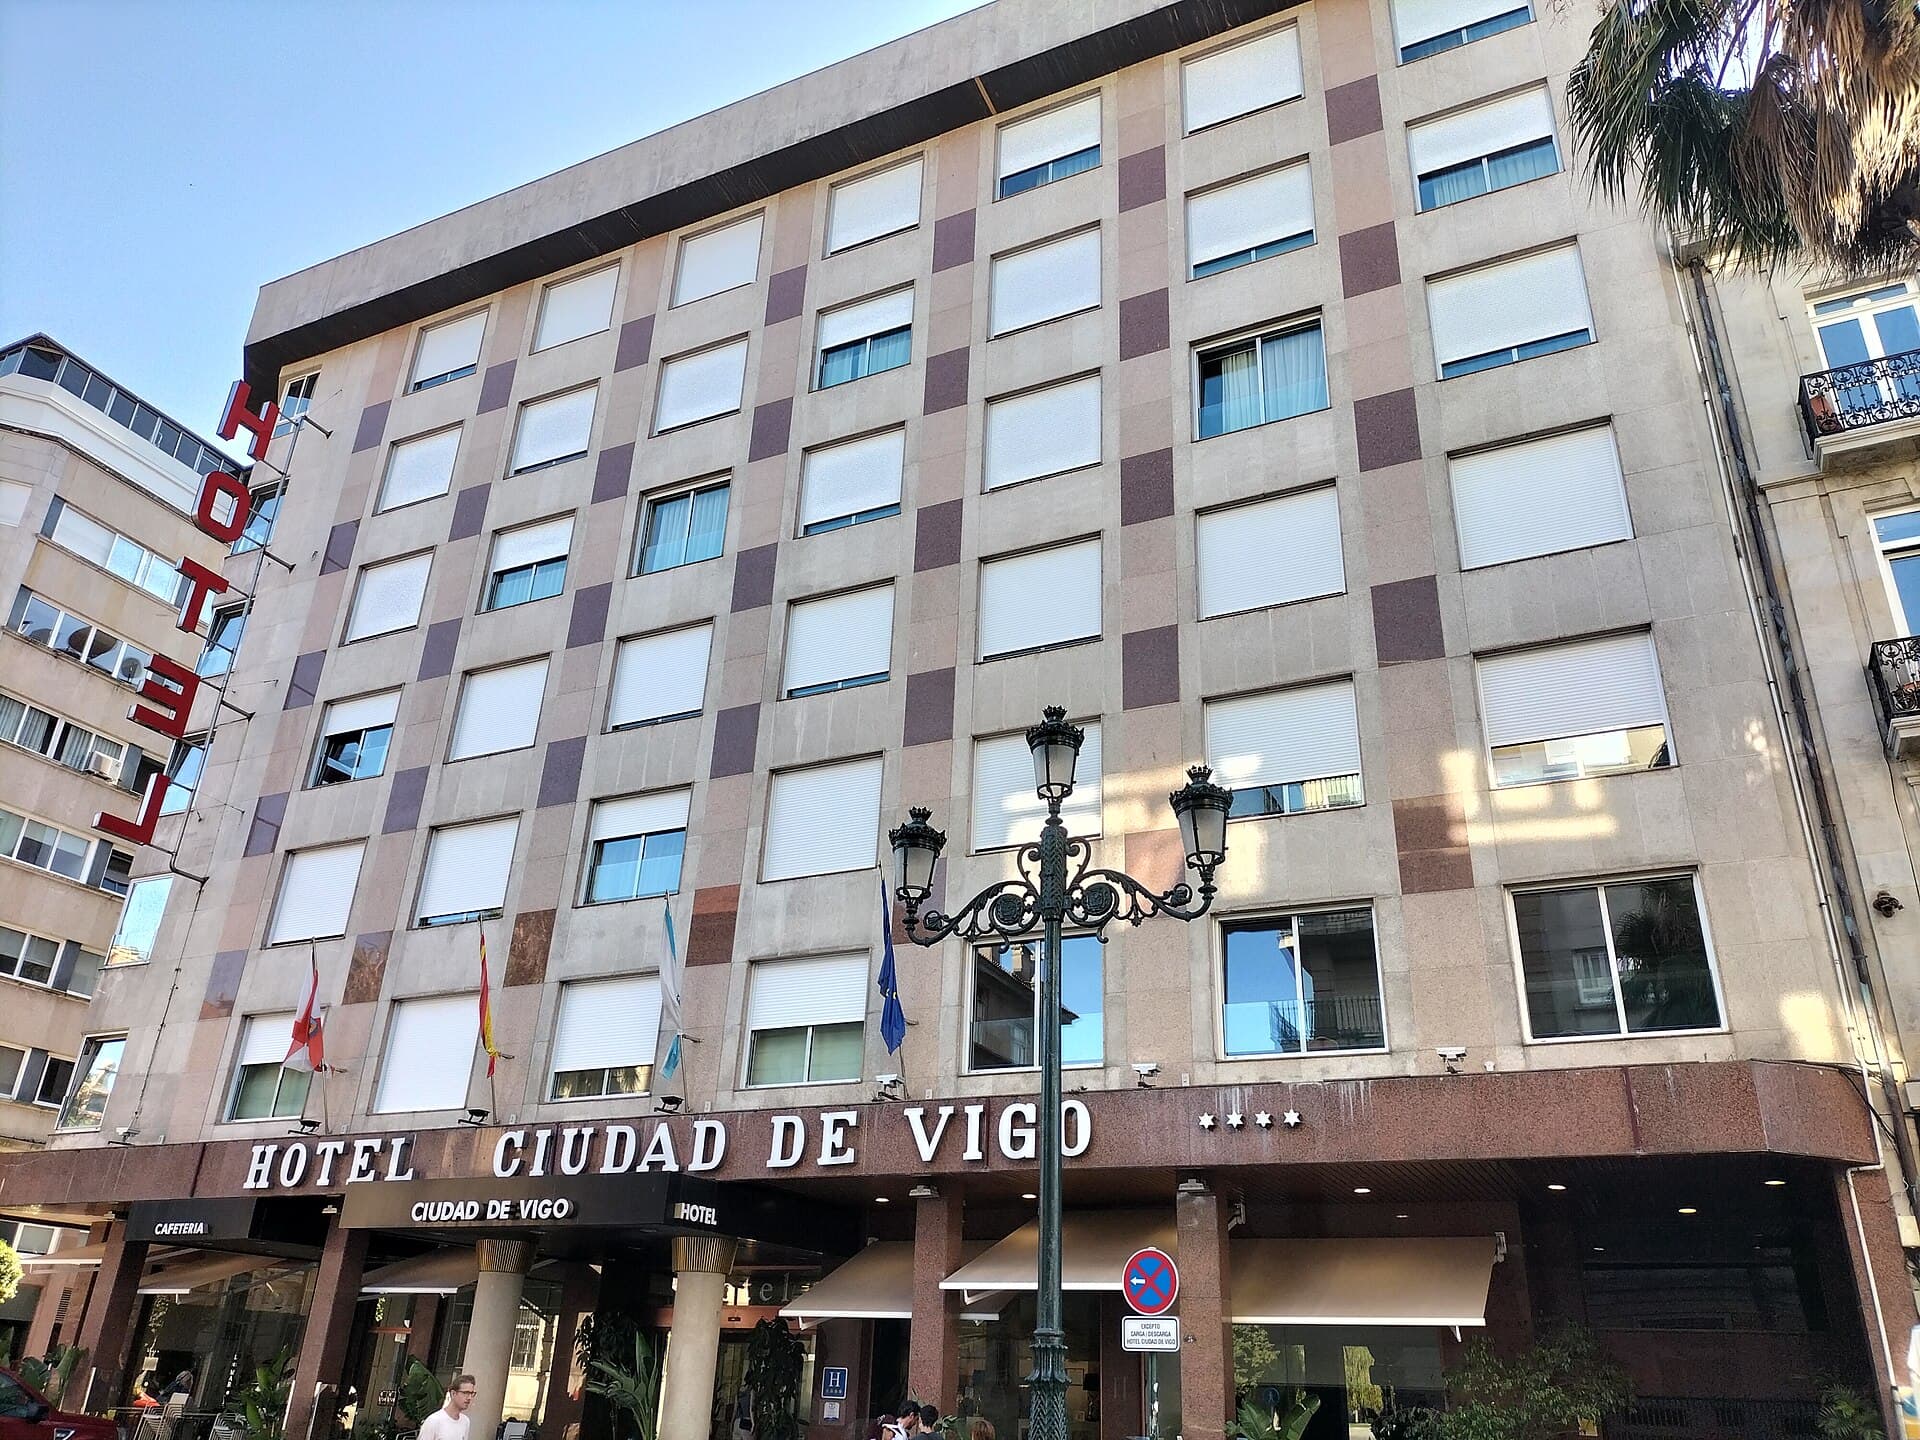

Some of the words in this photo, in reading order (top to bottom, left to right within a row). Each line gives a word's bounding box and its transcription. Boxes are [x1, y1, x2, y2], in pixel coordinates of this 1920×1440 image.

[243, 1137, 414, 1189] HOTEL
[493, 1120, 726, 1178] CIUDAD
[766, 1110, 858, 1168] DE
[903, 1099, 1091, 1162] VIGO
[411, 1201, 480, 1221] CIUDAD
[486, 1199, 512, 1220] DE
[520, 1198, 569, 1219] VIGO
[680, 1202, 717, 1226] HOTEL
[154, 1222, 204, 1235] CAFETERIA
[829, 1371, 841, 1388] H
